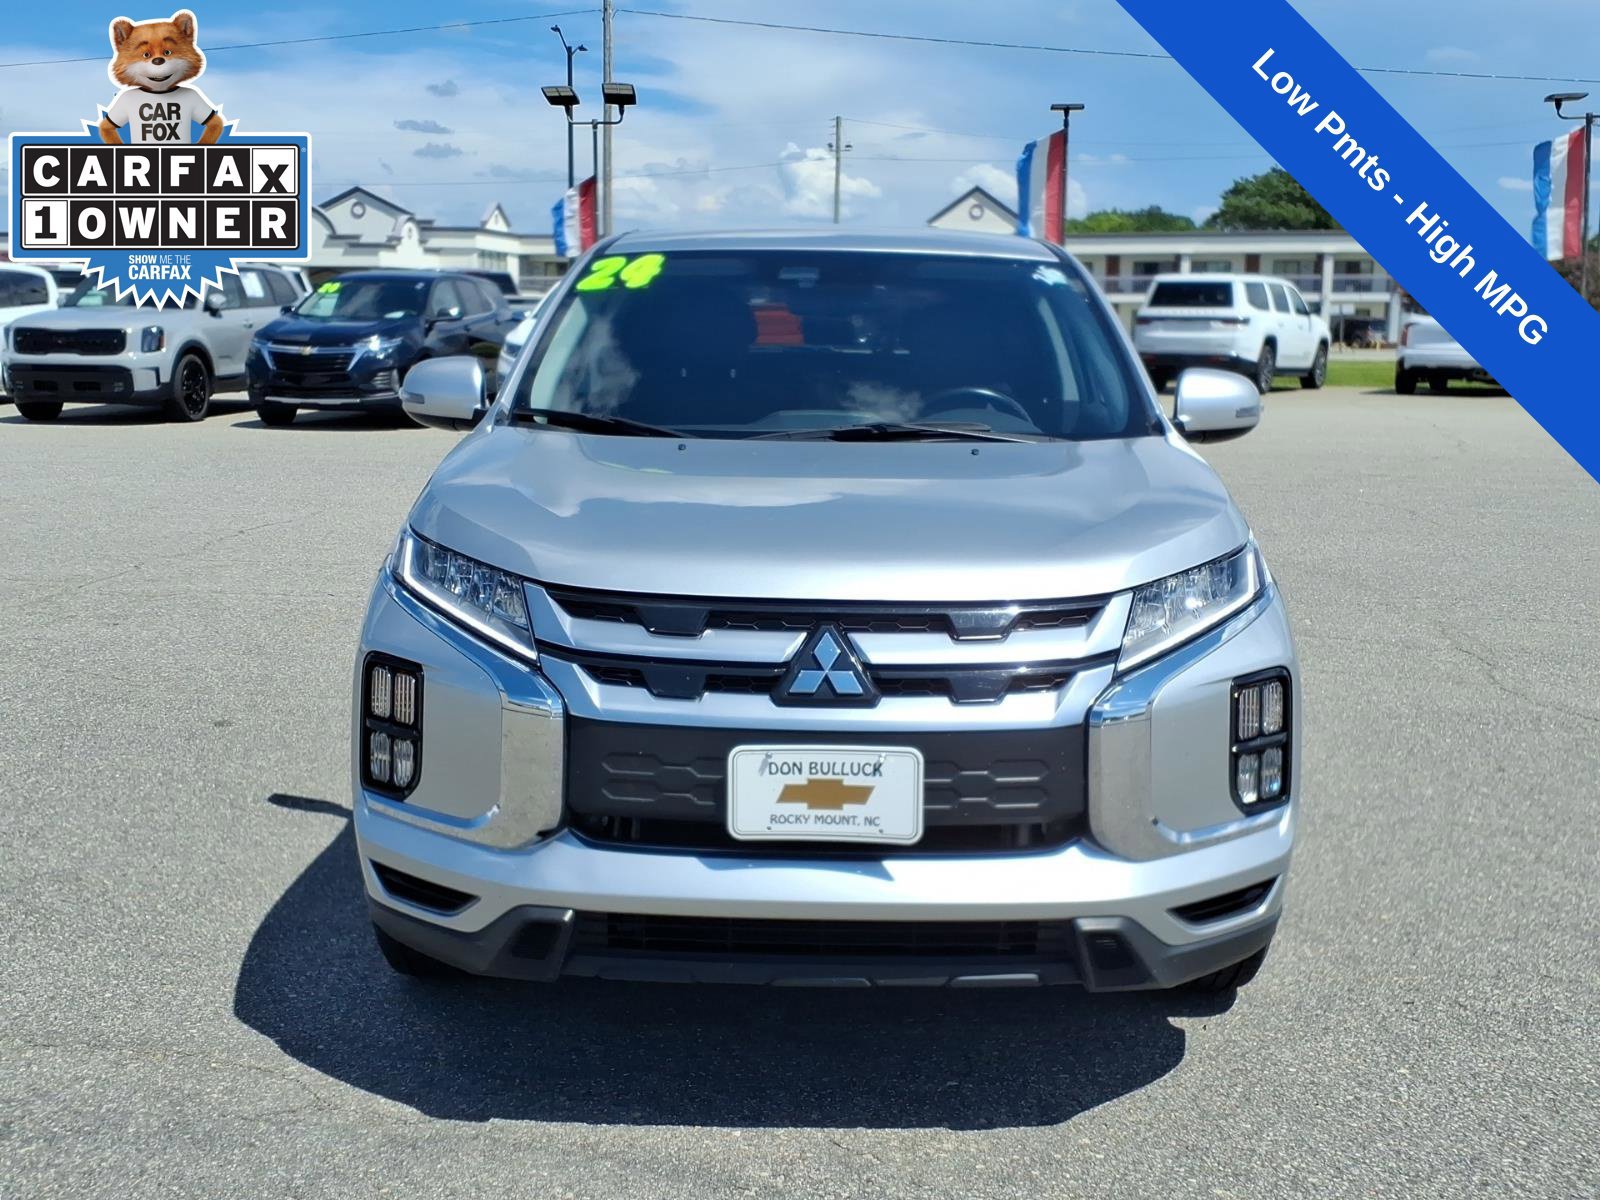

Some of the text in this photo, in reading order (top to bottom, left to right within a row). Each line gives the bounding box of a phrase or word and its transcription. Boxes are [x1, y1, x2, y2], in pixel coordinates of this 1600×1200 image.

[575, 253, 665, 291] 24
[768, 761, 884, 777] DON BULLUCK
[769, 814, 810, 825] ROCKY
[864, 816, 881, 827] NC
